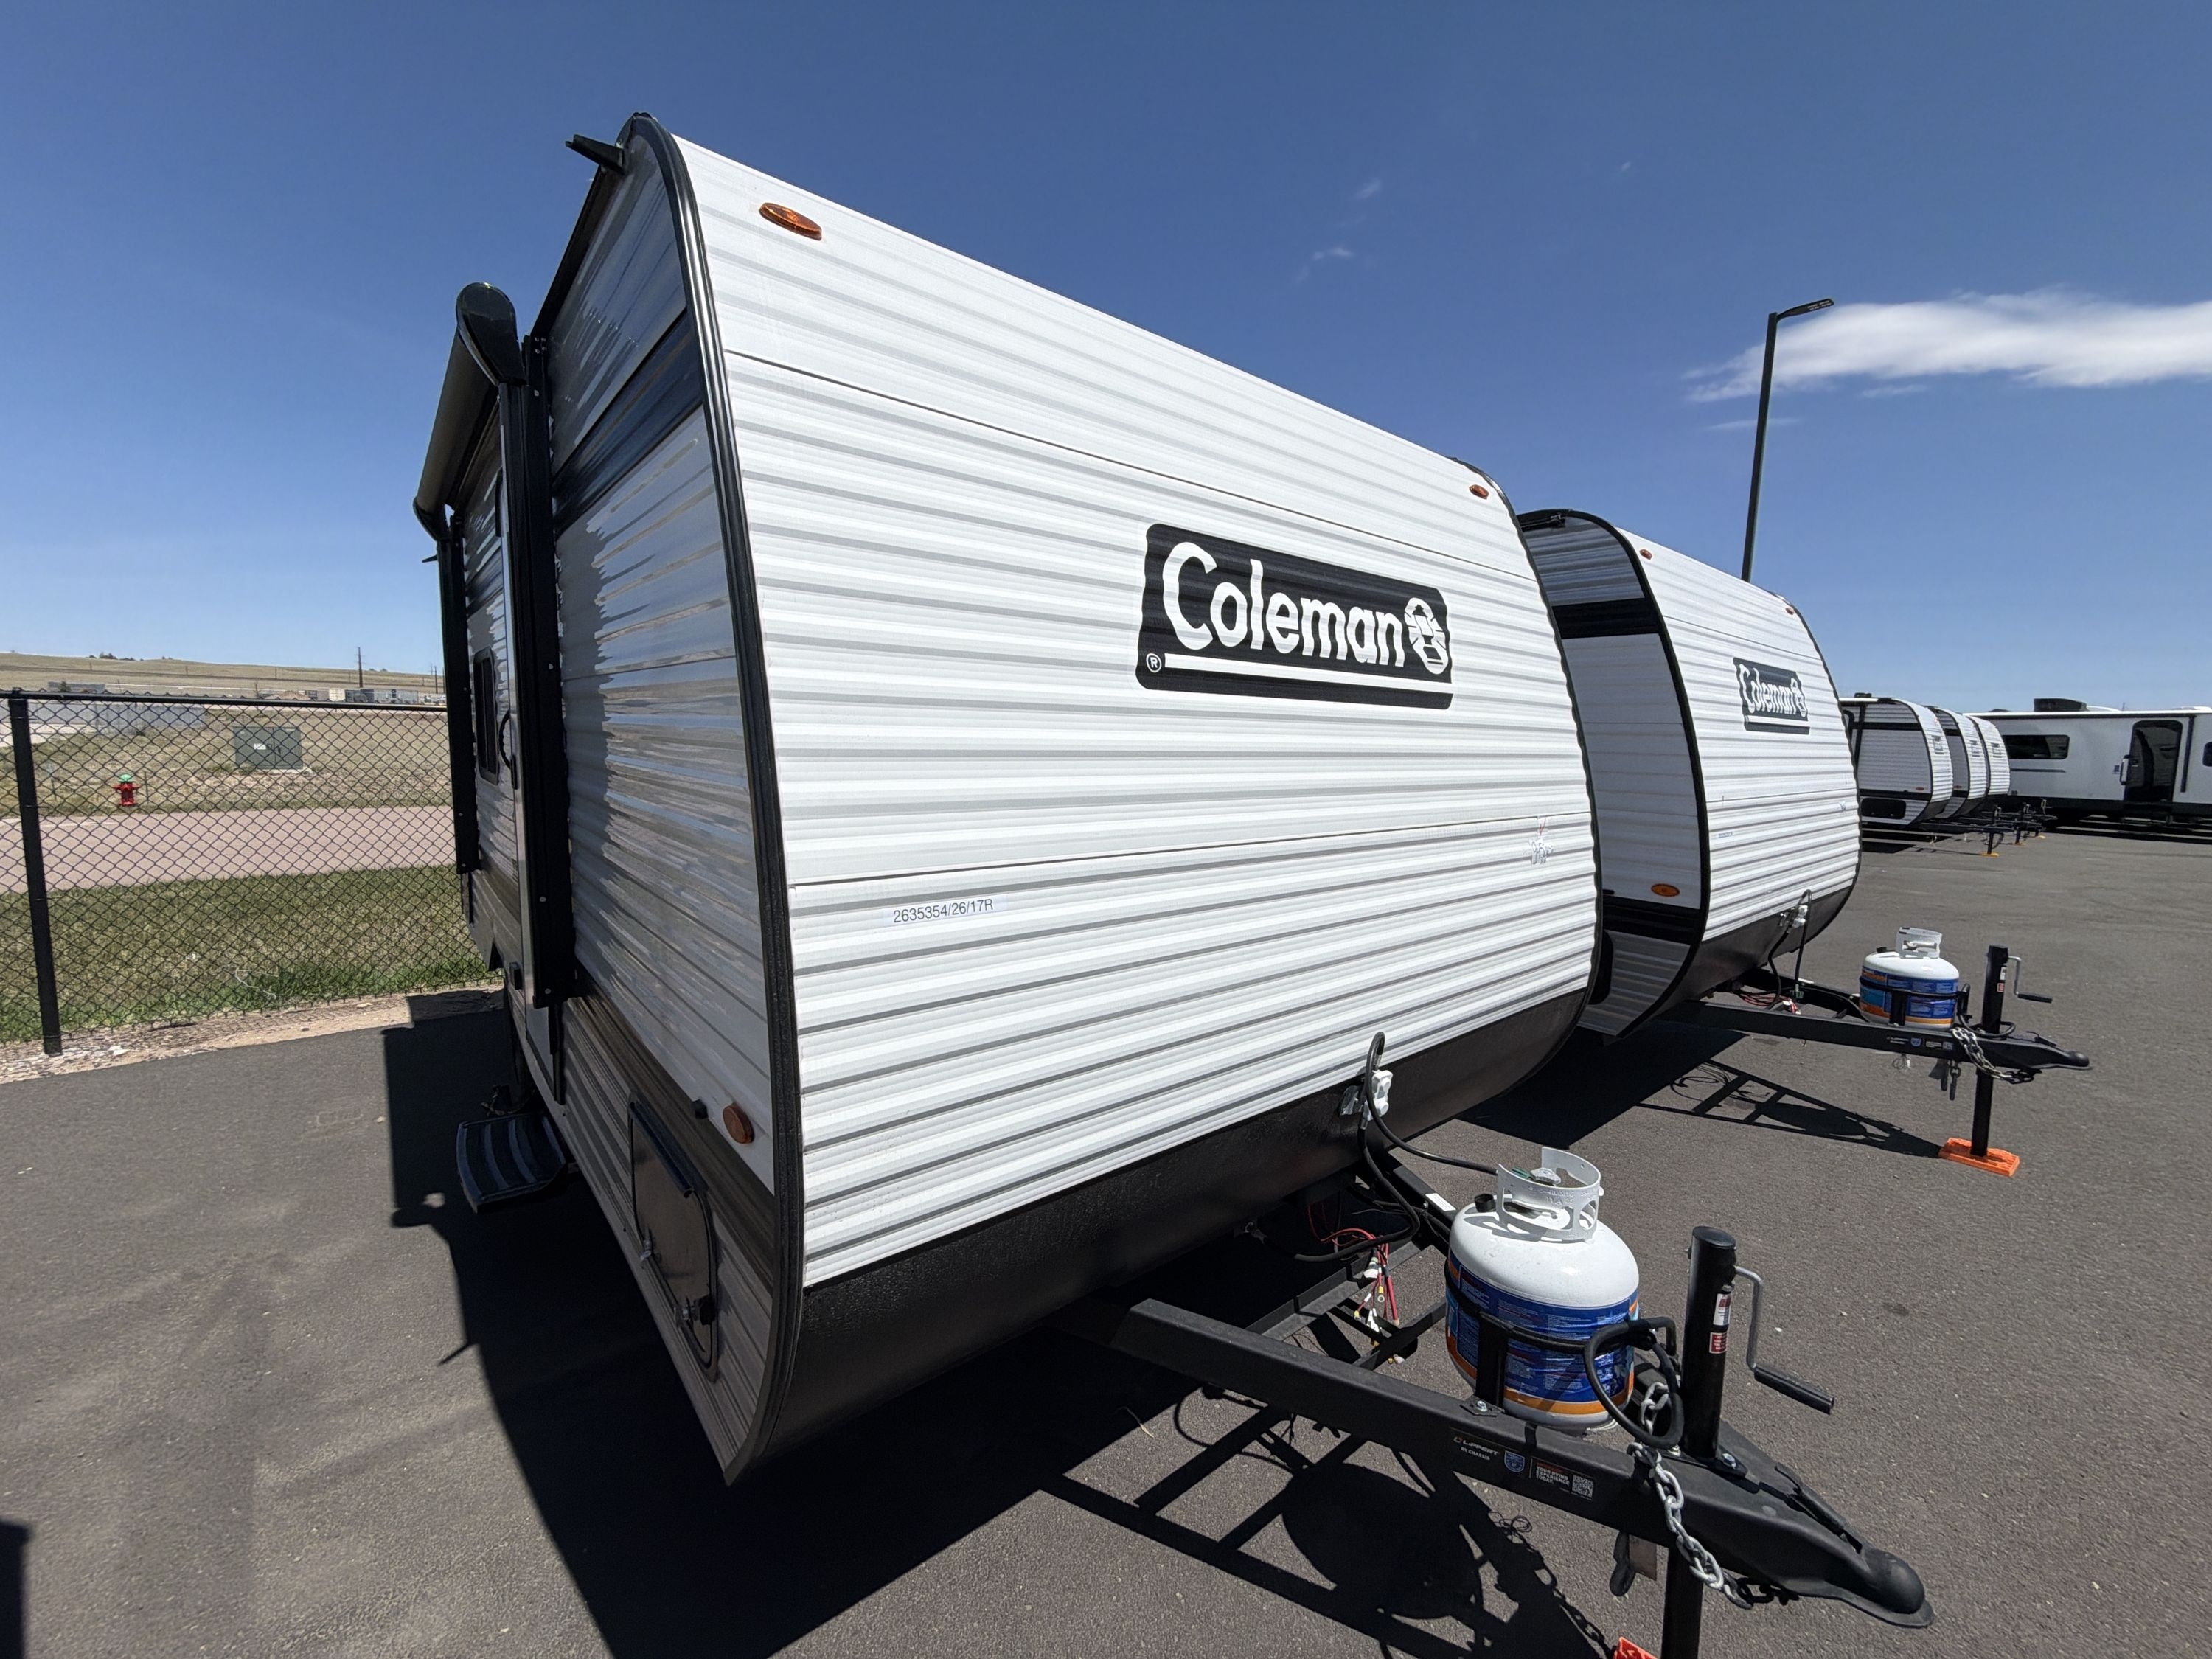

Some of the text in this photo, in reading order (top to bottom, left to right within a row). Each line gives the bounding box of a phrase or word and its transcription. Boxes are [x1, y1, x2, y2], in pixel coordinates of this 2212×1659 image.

[1162, 541, 1405, 667] Coleman
[1739, 663, 1797, 715] Coleman
[893, 898, 994, 923] 2635354/26/17R
[1536, 1466, 1551, 1475] YOUR
